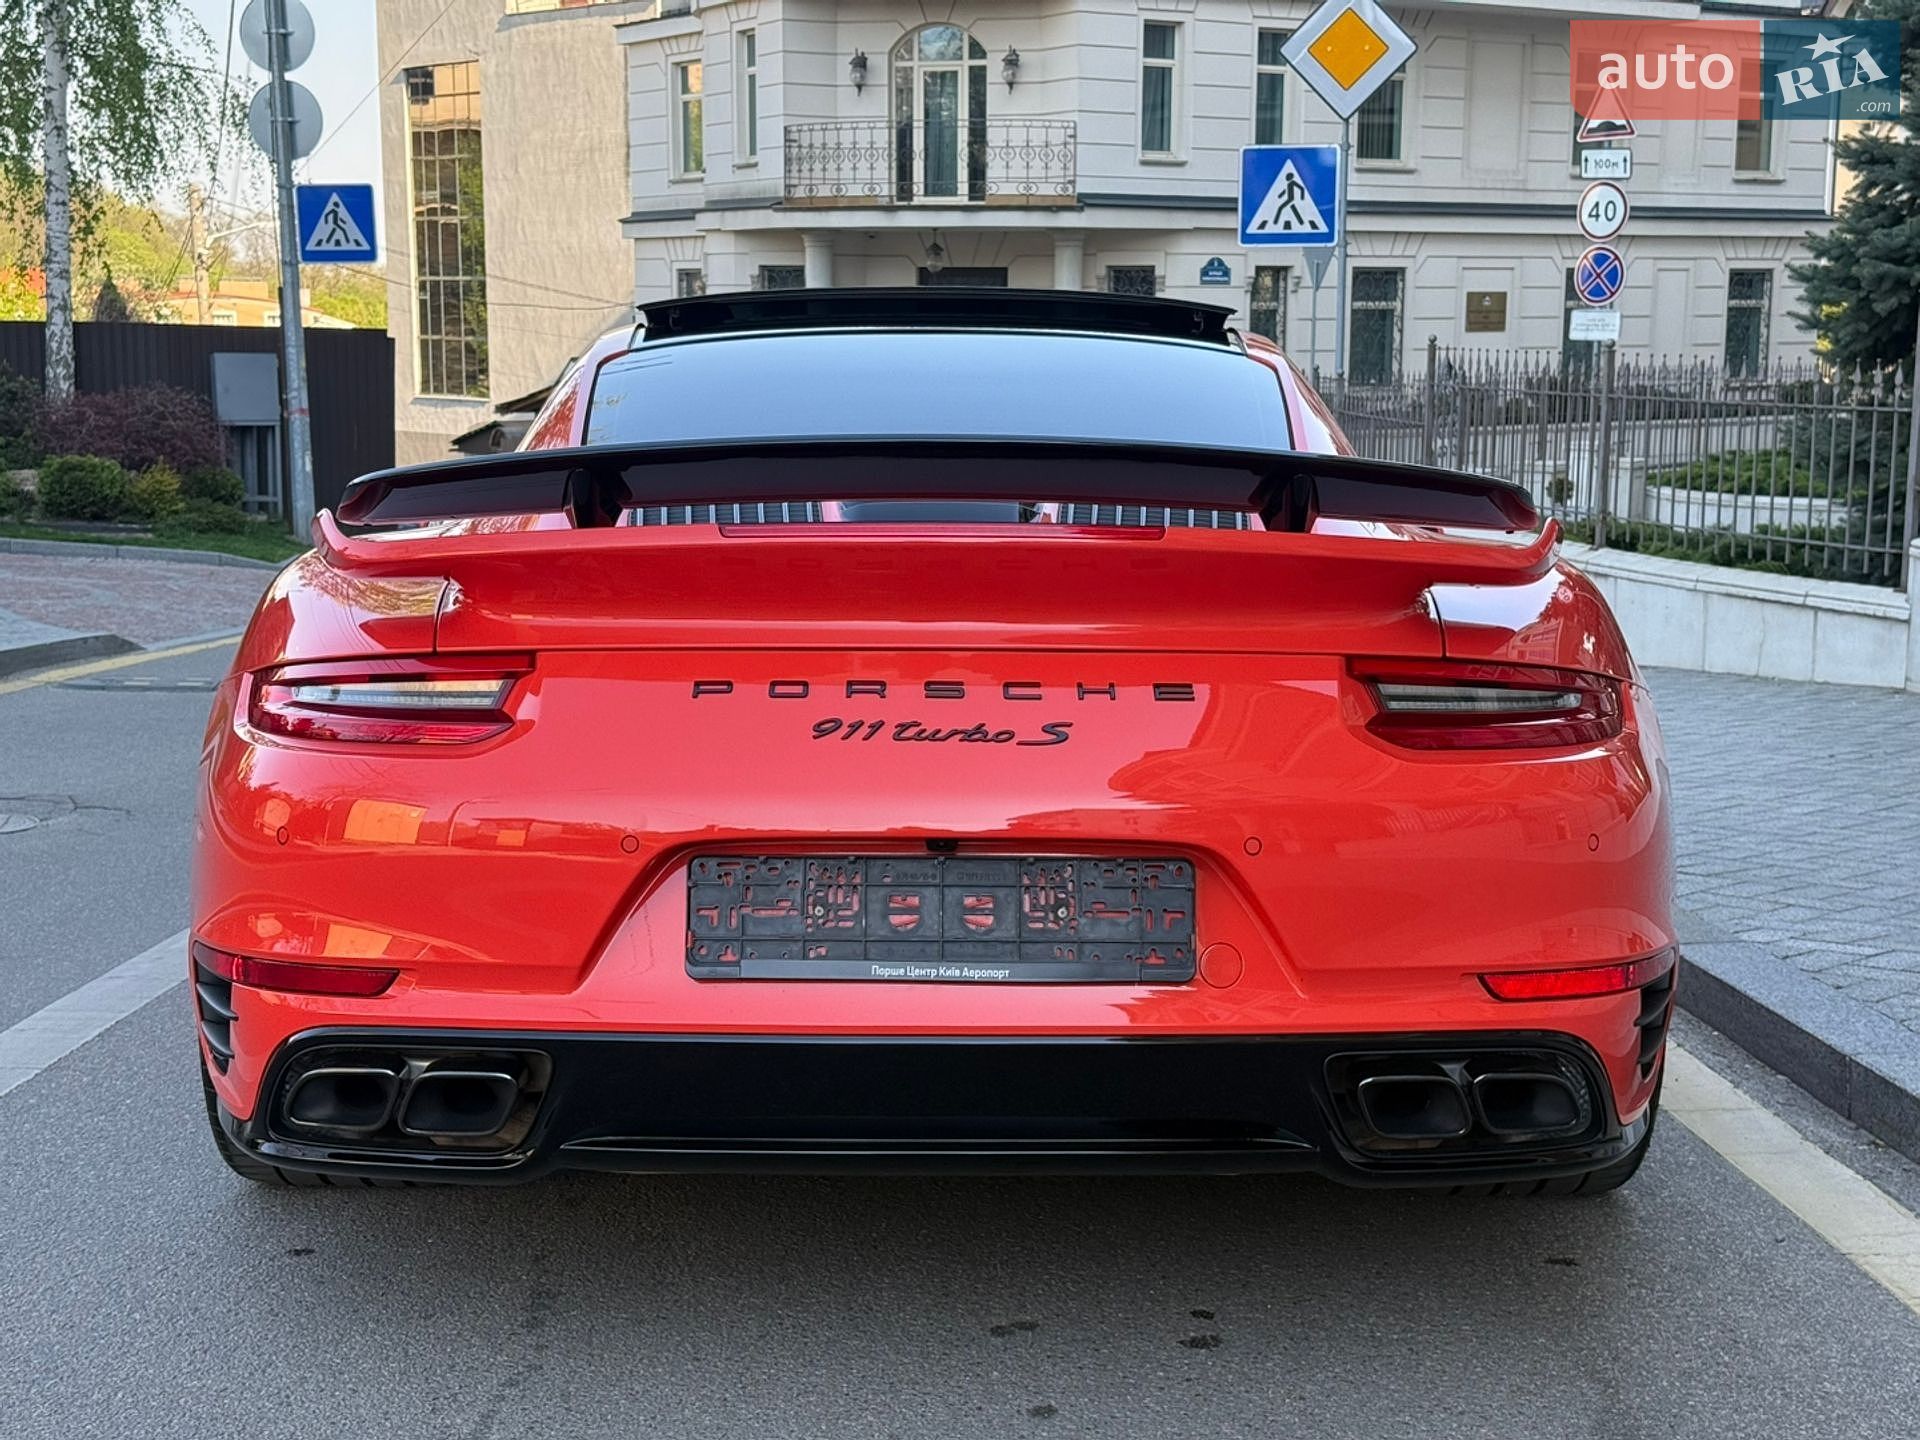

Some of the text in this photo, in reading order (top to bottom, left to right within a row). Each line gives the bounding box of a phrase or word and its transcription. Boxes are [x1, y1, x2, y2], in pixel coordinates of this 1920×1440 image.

[1588, 200, 1617, 223] 40
[692, 680, 1195, 701] PORSCHE
[811, 717, 1073, 746] 911 turbo S
[871, 965, 1009, 978] Порше Центр Київ Аеропорт
